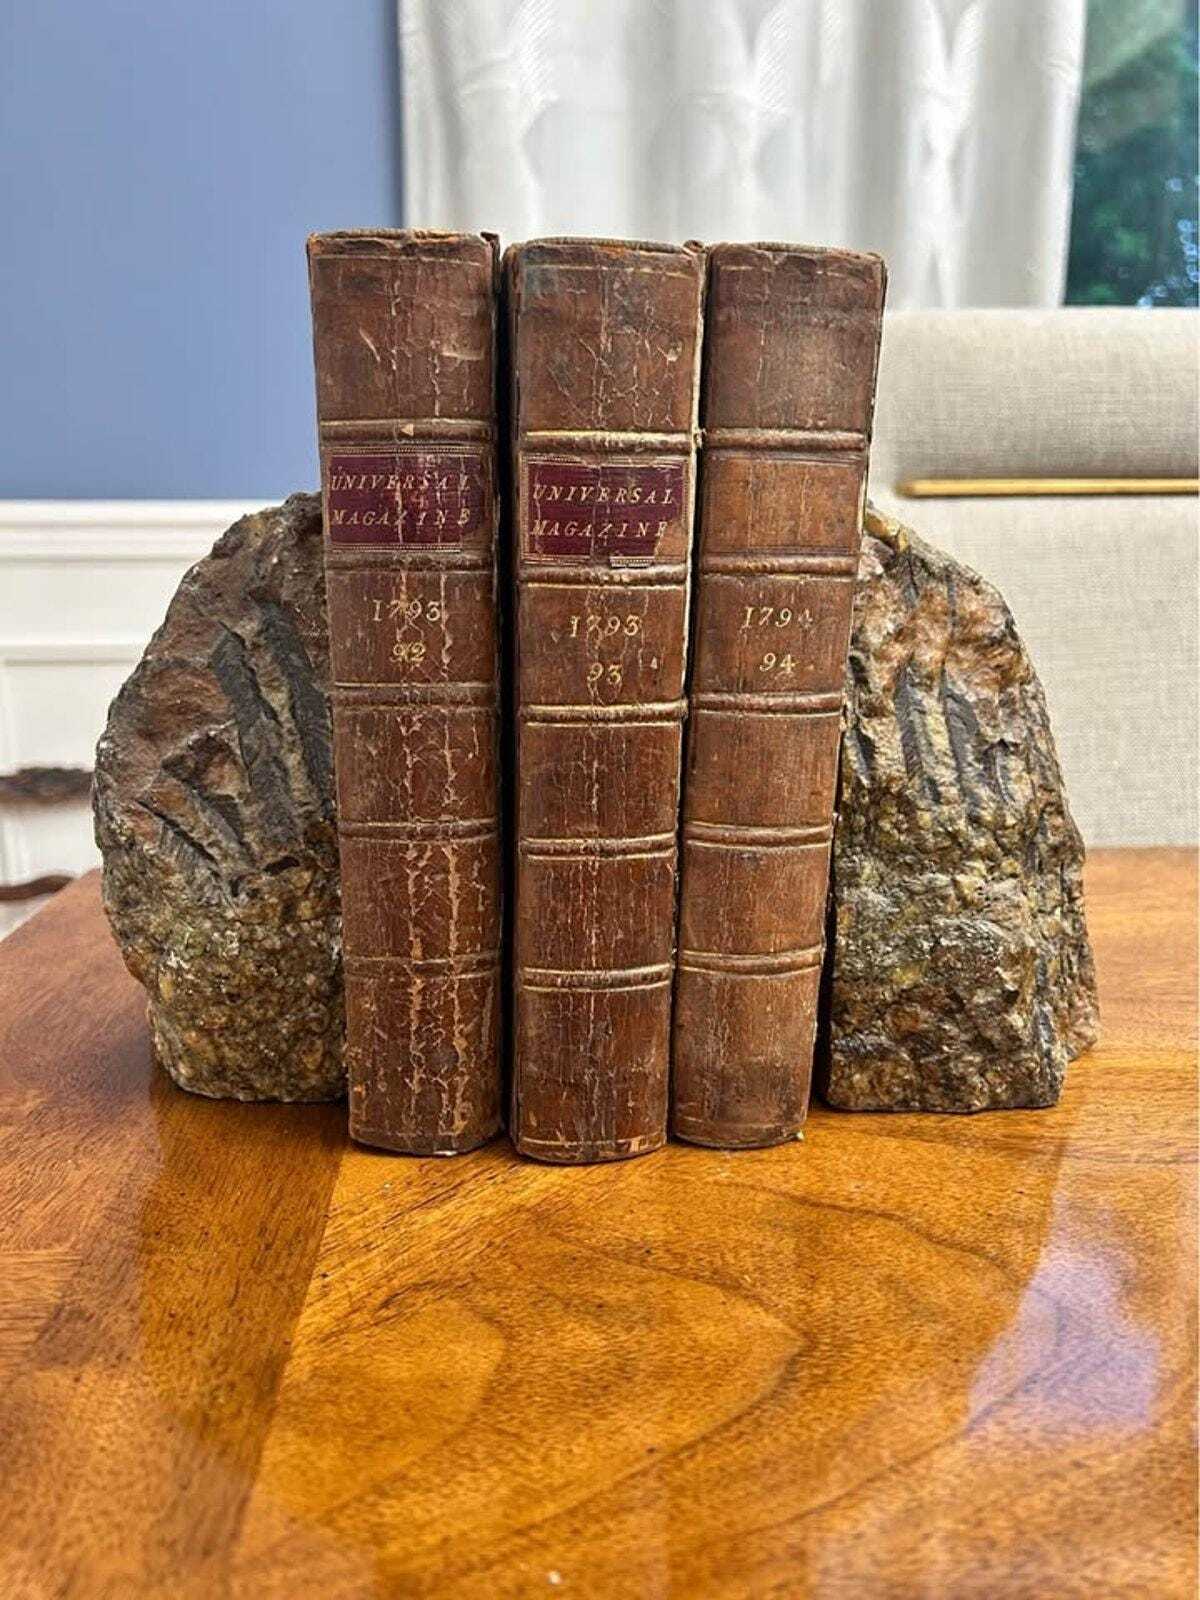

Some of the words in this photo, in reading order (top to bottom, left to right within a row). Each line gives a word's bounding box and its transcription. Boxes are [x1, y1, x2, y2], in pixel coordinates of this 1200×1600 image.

[331, 470, 470, 490] UNIVERSAL
[532, 484, 673, 505] UNIVERSAL
[570, 614, 640, 638] 1793
[587, 662, 622, 685] 93
[759, 652, 797, 674] 94
